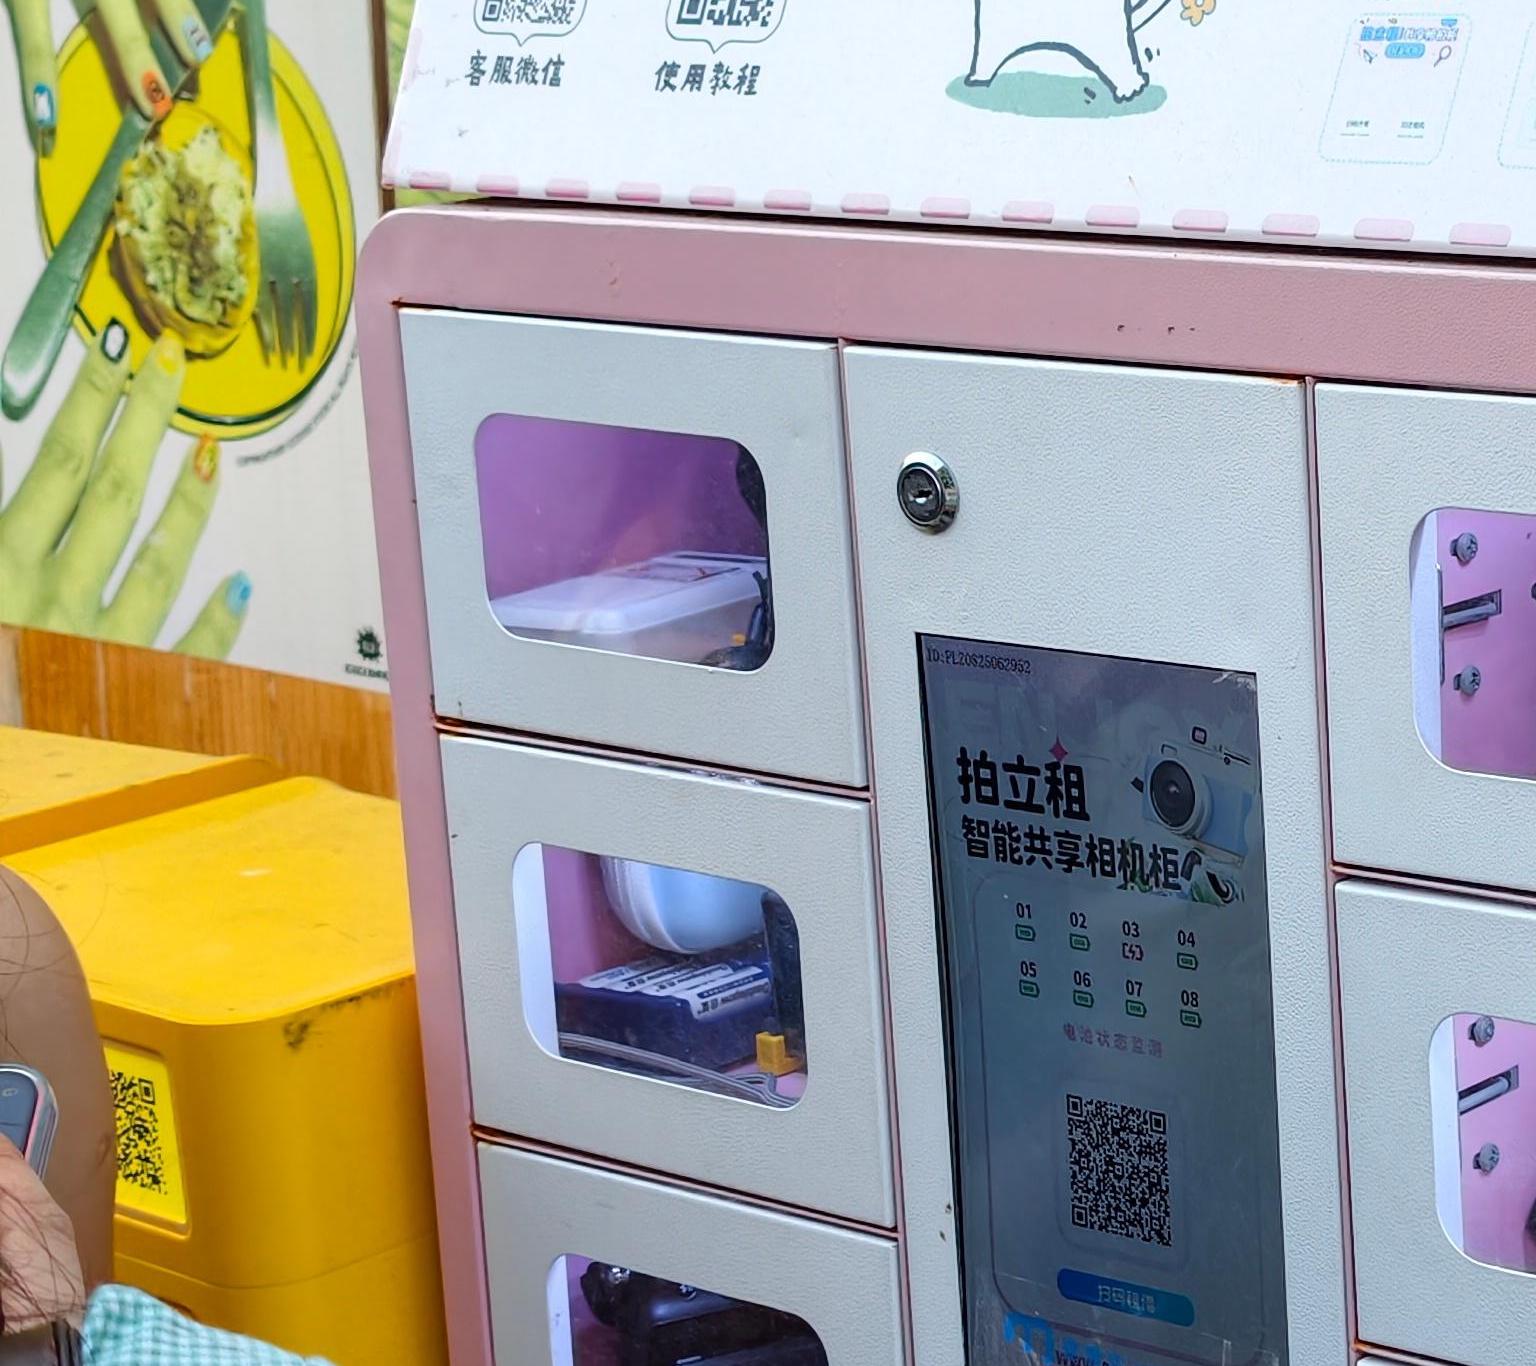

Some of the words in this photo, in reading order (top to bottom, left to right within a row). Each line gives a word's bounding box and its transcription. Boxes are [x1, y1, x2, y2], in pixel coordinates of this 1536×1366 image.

[464, 51, 566, 89] 客服微信
[654, 61, 762, 97] 使用教程
[957, 746, 1090, 822] 拍立租
[961, 814, 1183, 892] 智能共享相机柜
[1016, 902, 1032, 920] 01
[1069, 912, 1088, 930] 02
[1122, 921, 1140, 938] 03
[1177, 930, 1196, 948] 04
[1020, 961, 1037, 978] 05
[1073, 971, 1091, 988] 06
[1125, 980, 1143, 997] 07
[1181, 990, 1199, 1008] 08
